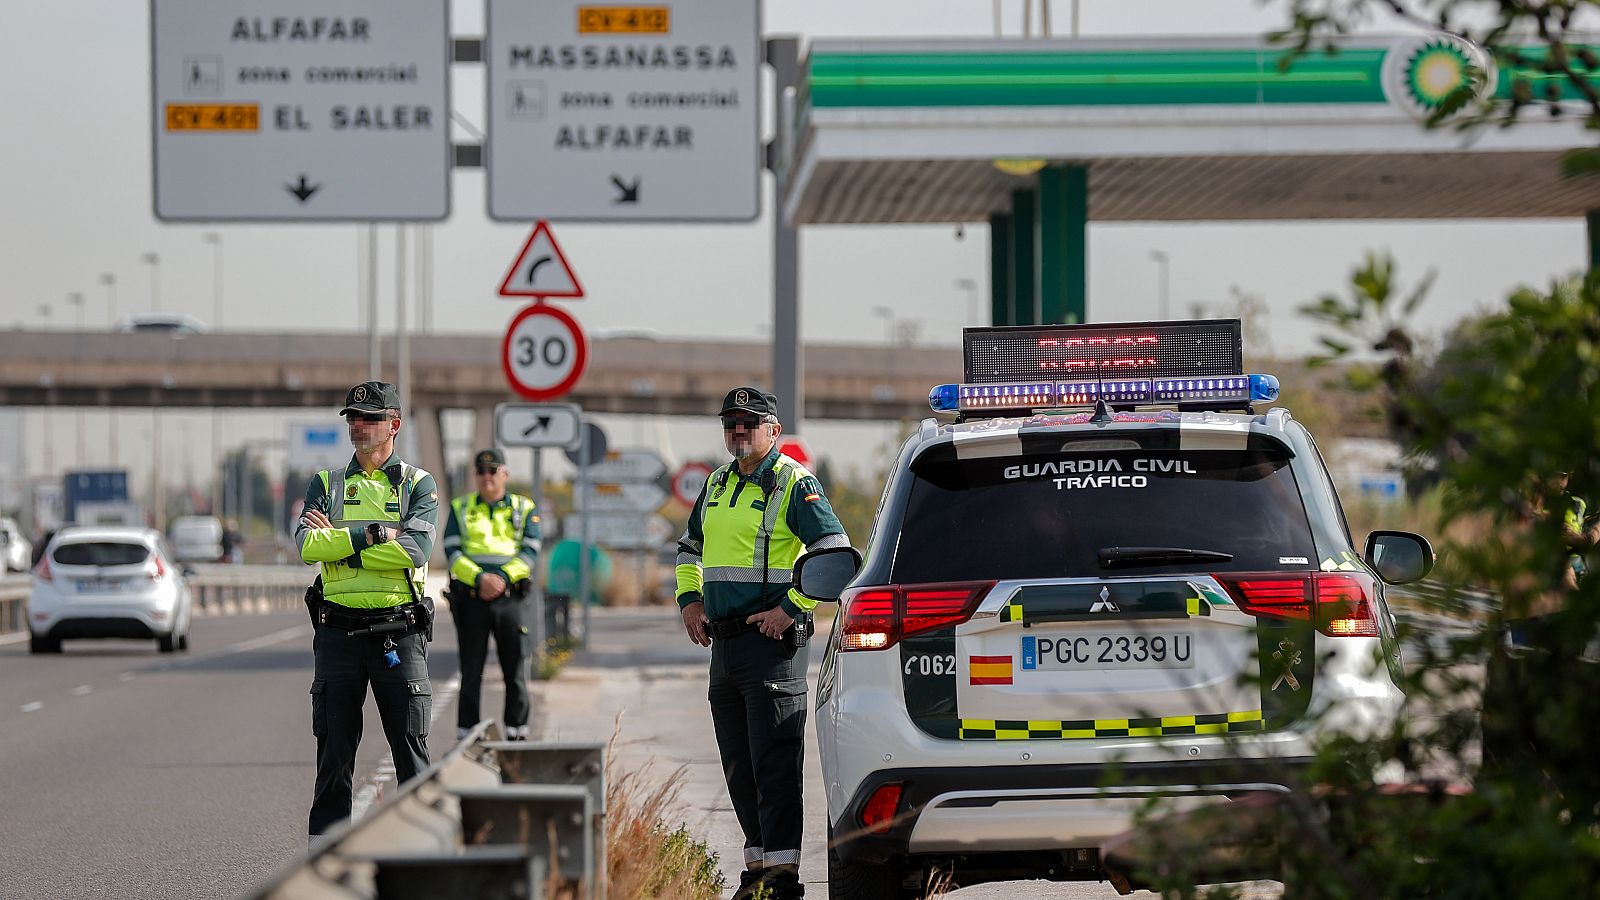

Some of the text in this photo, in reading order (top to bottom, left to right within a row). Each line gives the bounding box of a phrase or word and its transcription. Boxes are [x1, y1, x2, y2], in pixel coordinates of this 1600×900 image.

[231, 17, 371, 41] ALFAFAR
[509, 45, 737, 69] MASSANASSA
[237, 63, 418, 83] zona comercial
[560, 88, 739, 108] zona comercial
[275, 105, 433, 130] EL SALER
[555, 125, 693, 148] ALFAFAR
[517, 337, 567, 367] 30
[1004, 459, 1197, 479] GUARDIA CIVIL
[1053, 474, 1148, 490] TRÁFICO
[1037, 635, 1191, 665] PGC 2339 U
[920, 655, 956, 676] 062
